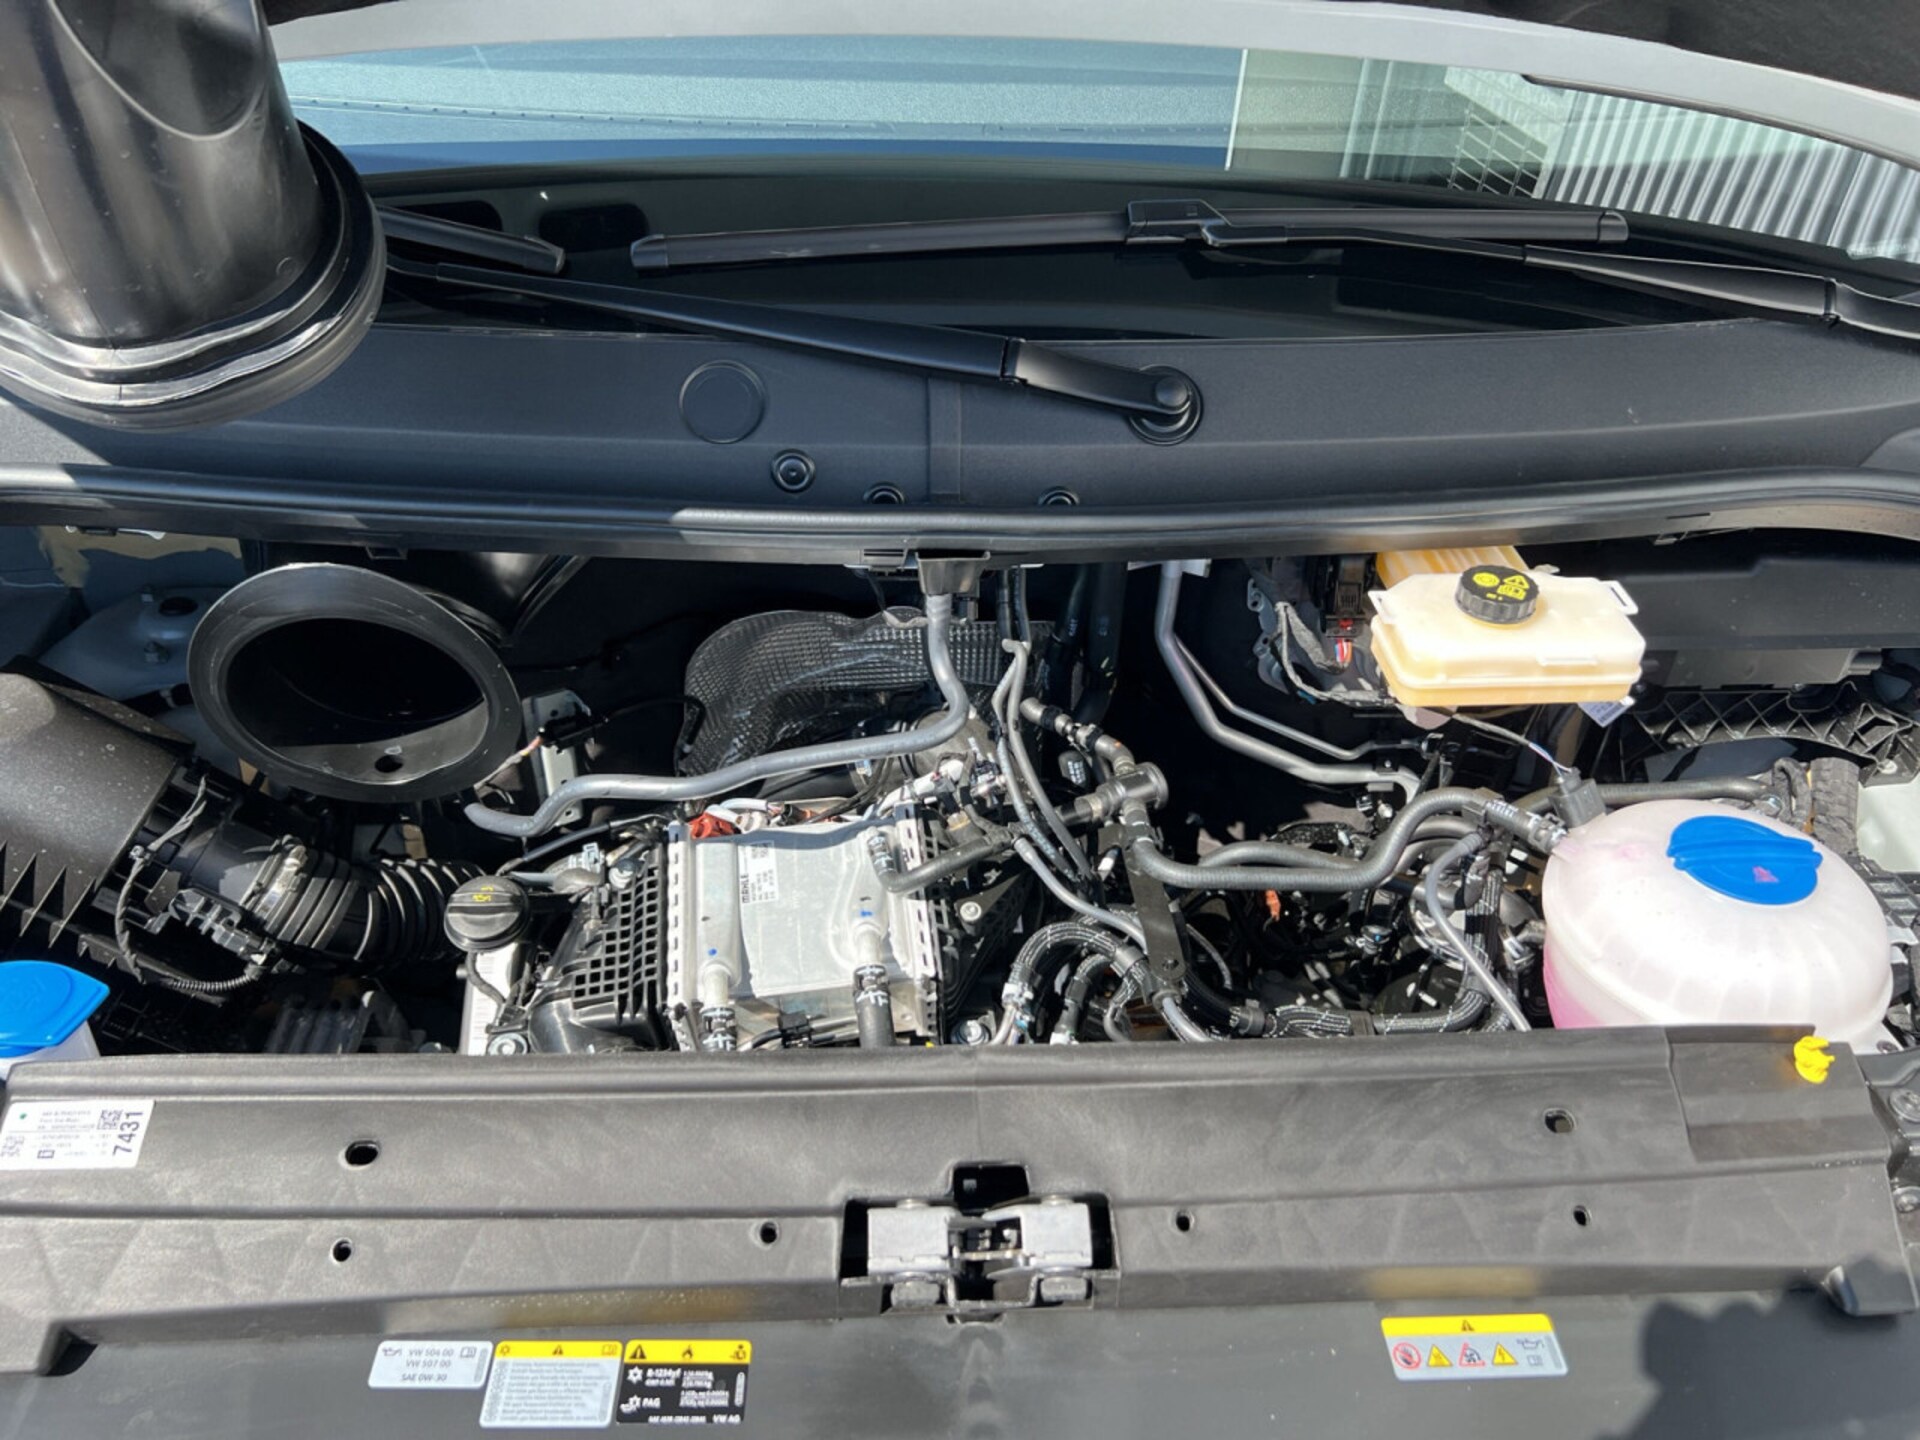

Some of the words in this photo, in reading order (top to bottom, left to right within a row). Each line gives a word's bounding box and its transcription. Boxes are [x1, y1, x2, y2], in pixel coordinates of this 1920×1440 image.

[741, 874, 749, 903] MAHLE
[112, 1110, 144, 1156] 7431
[408, 1348, 422, 1356] VW
[425, 1348, 441, 1356] 504
[442, 1348, 454, 1356] 00
[406, 1359, 420, 1368] VW
[422, 1359, 438, 1368] 507
[439, 1359, 452, 1368] 00
[401, 1373, 416, 1382] SAE
[642, 1397, 660, 1408] PAG
[713, 1414, 727, 1424] VW
[728, 1414, 741, 1424] AG
